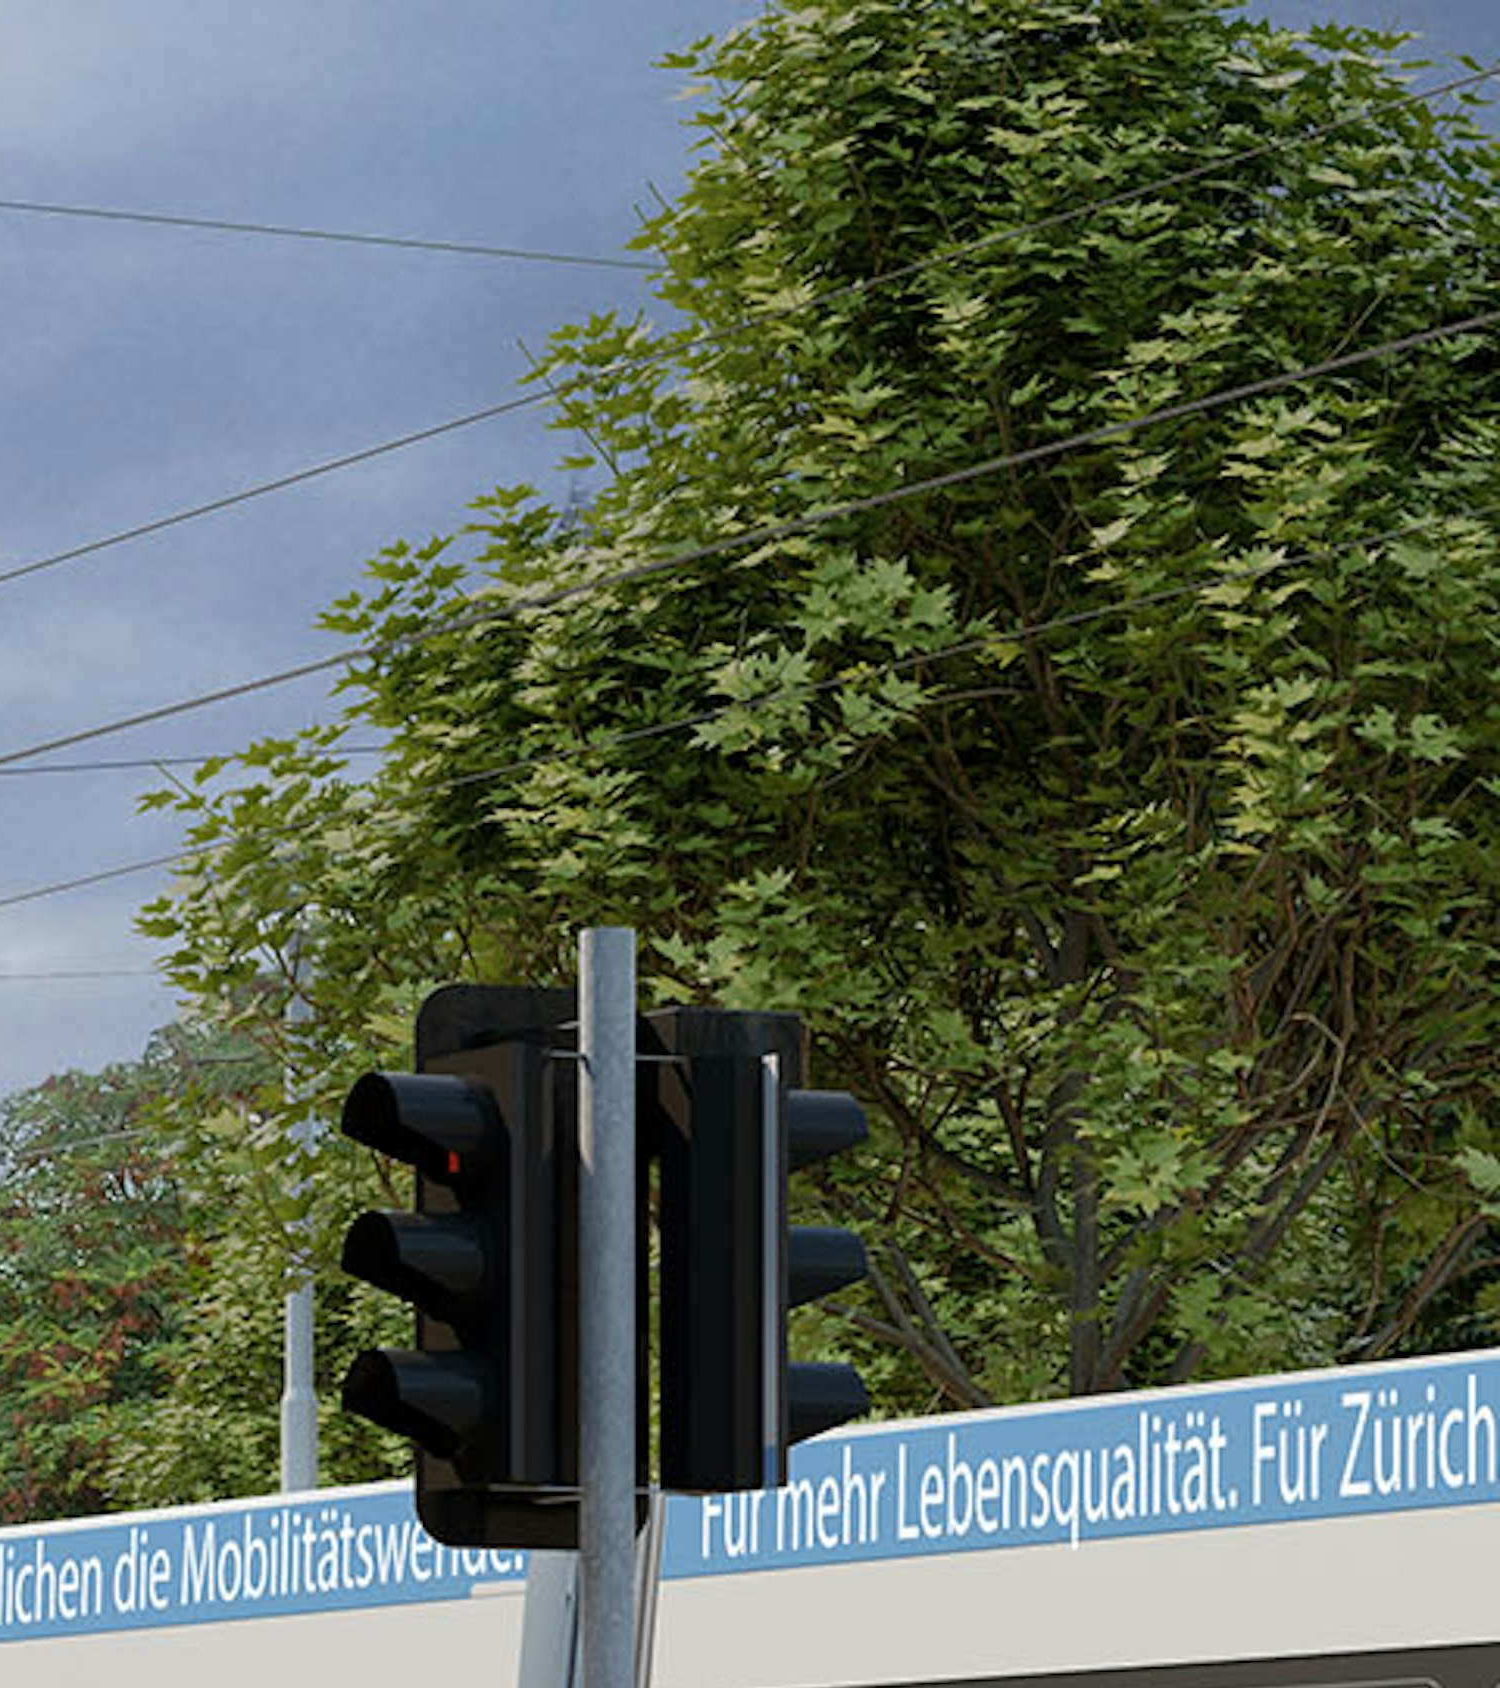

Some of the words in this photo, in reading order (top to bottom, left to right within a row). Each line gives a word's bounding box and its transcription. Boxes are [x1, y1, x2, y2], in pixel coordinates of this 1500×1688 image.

[777, 1444, 887, 1553] mehr
[896, 1409, 1240, 1550] Lebensqualität.
[1252, 1398, 1328, 1506] Für
[113, 1526, 173, 1614] die
